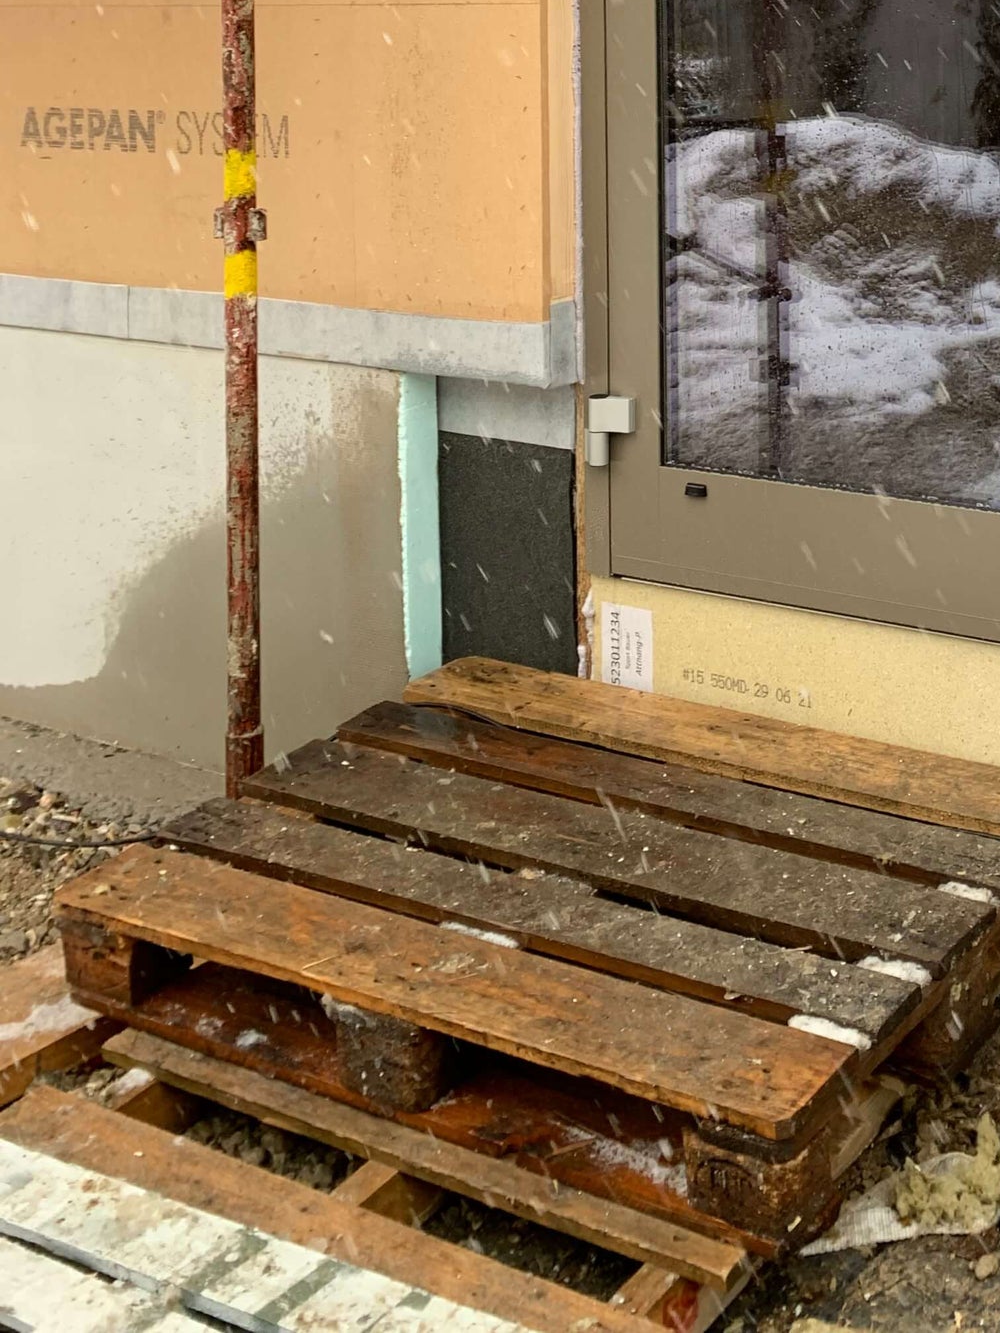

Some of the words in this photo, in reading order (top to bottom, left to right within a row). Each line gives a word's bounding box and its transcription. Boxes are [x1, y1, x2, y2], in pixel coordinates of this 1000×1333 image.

[176, 110, 289, 159] SYSM
[610, 611, 622, 685] 523011234
[682, 669, 704, 684] #15
[754, 682, 769, 698] 29
[775, 687, 791, 704] 06
